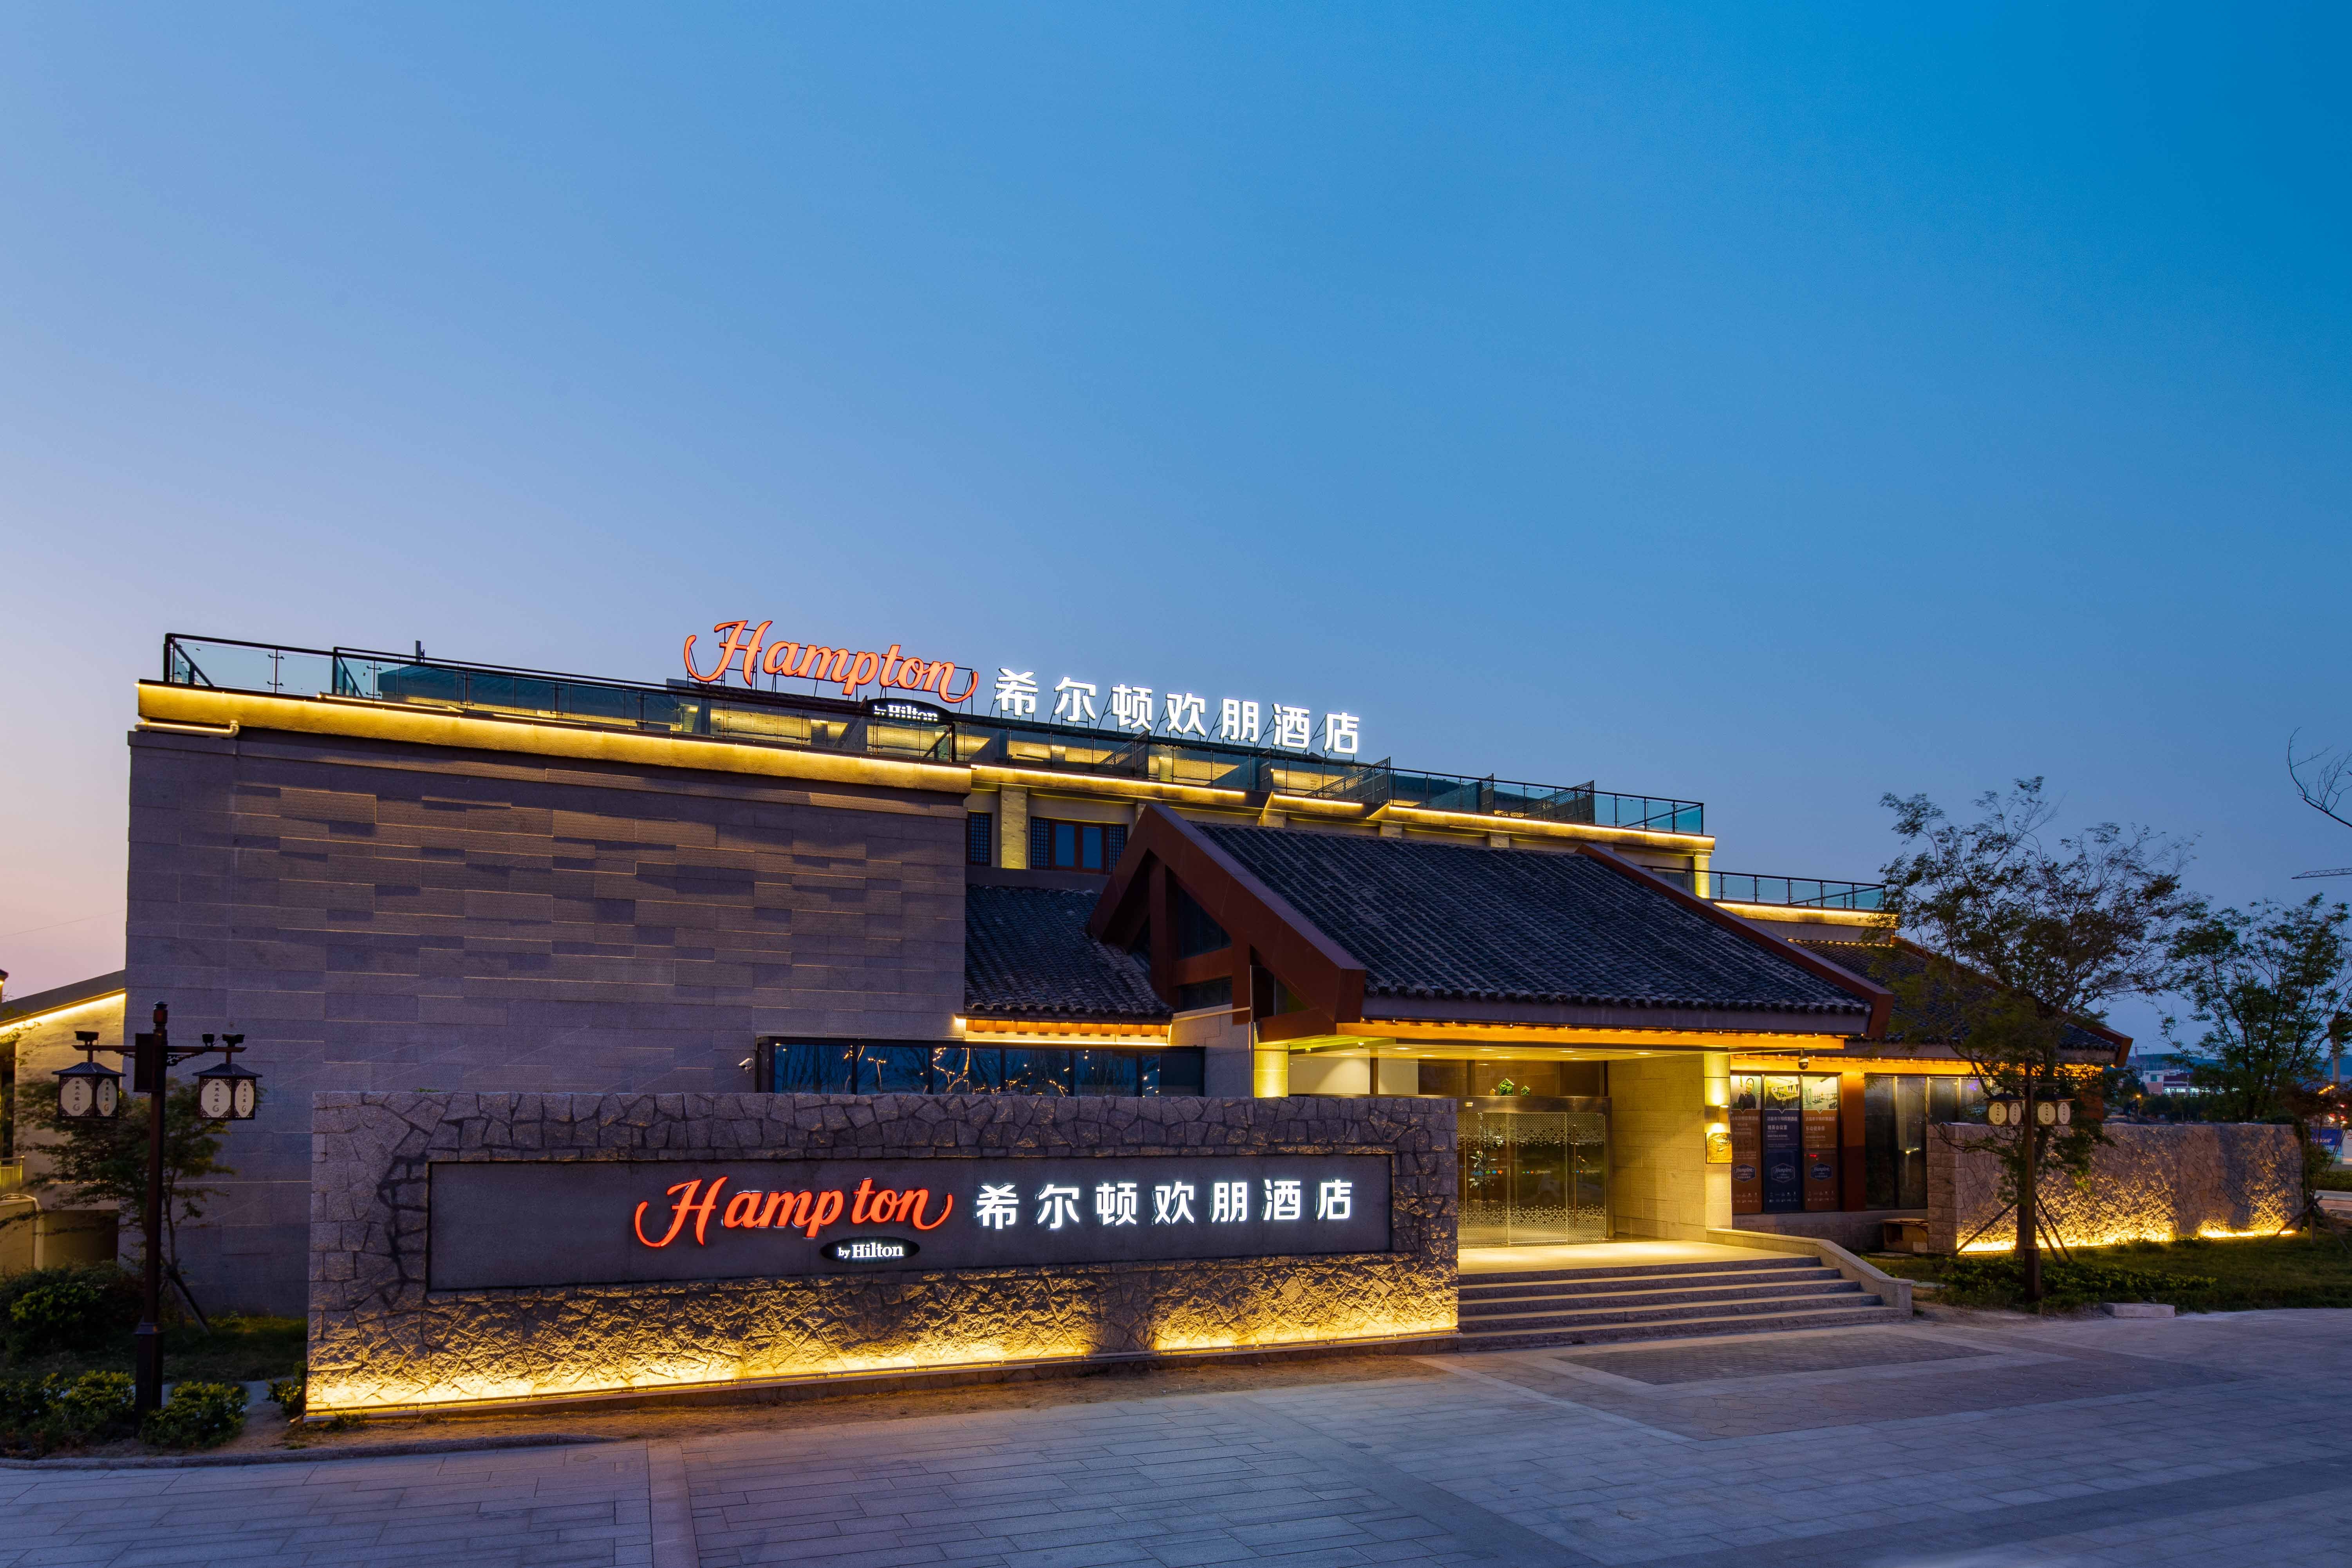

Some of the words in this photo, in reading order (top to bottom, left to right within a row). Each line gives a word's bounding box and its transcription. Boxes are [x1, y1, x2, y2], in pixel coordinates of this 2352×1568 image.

[684, 620, 979, 703] Hampton
[887, 705, 938, 722] Hilton
[995, 668, 1360, 754] 希尔顿欢朋酒店
[634, 1176, 953, 1248] Hampton
[976, 1178, 1353, 1230] 希尔顿欢朋酒店
[838, 1247, 851, 1259] by
[851, 1242, 904, 1258] Hilton
